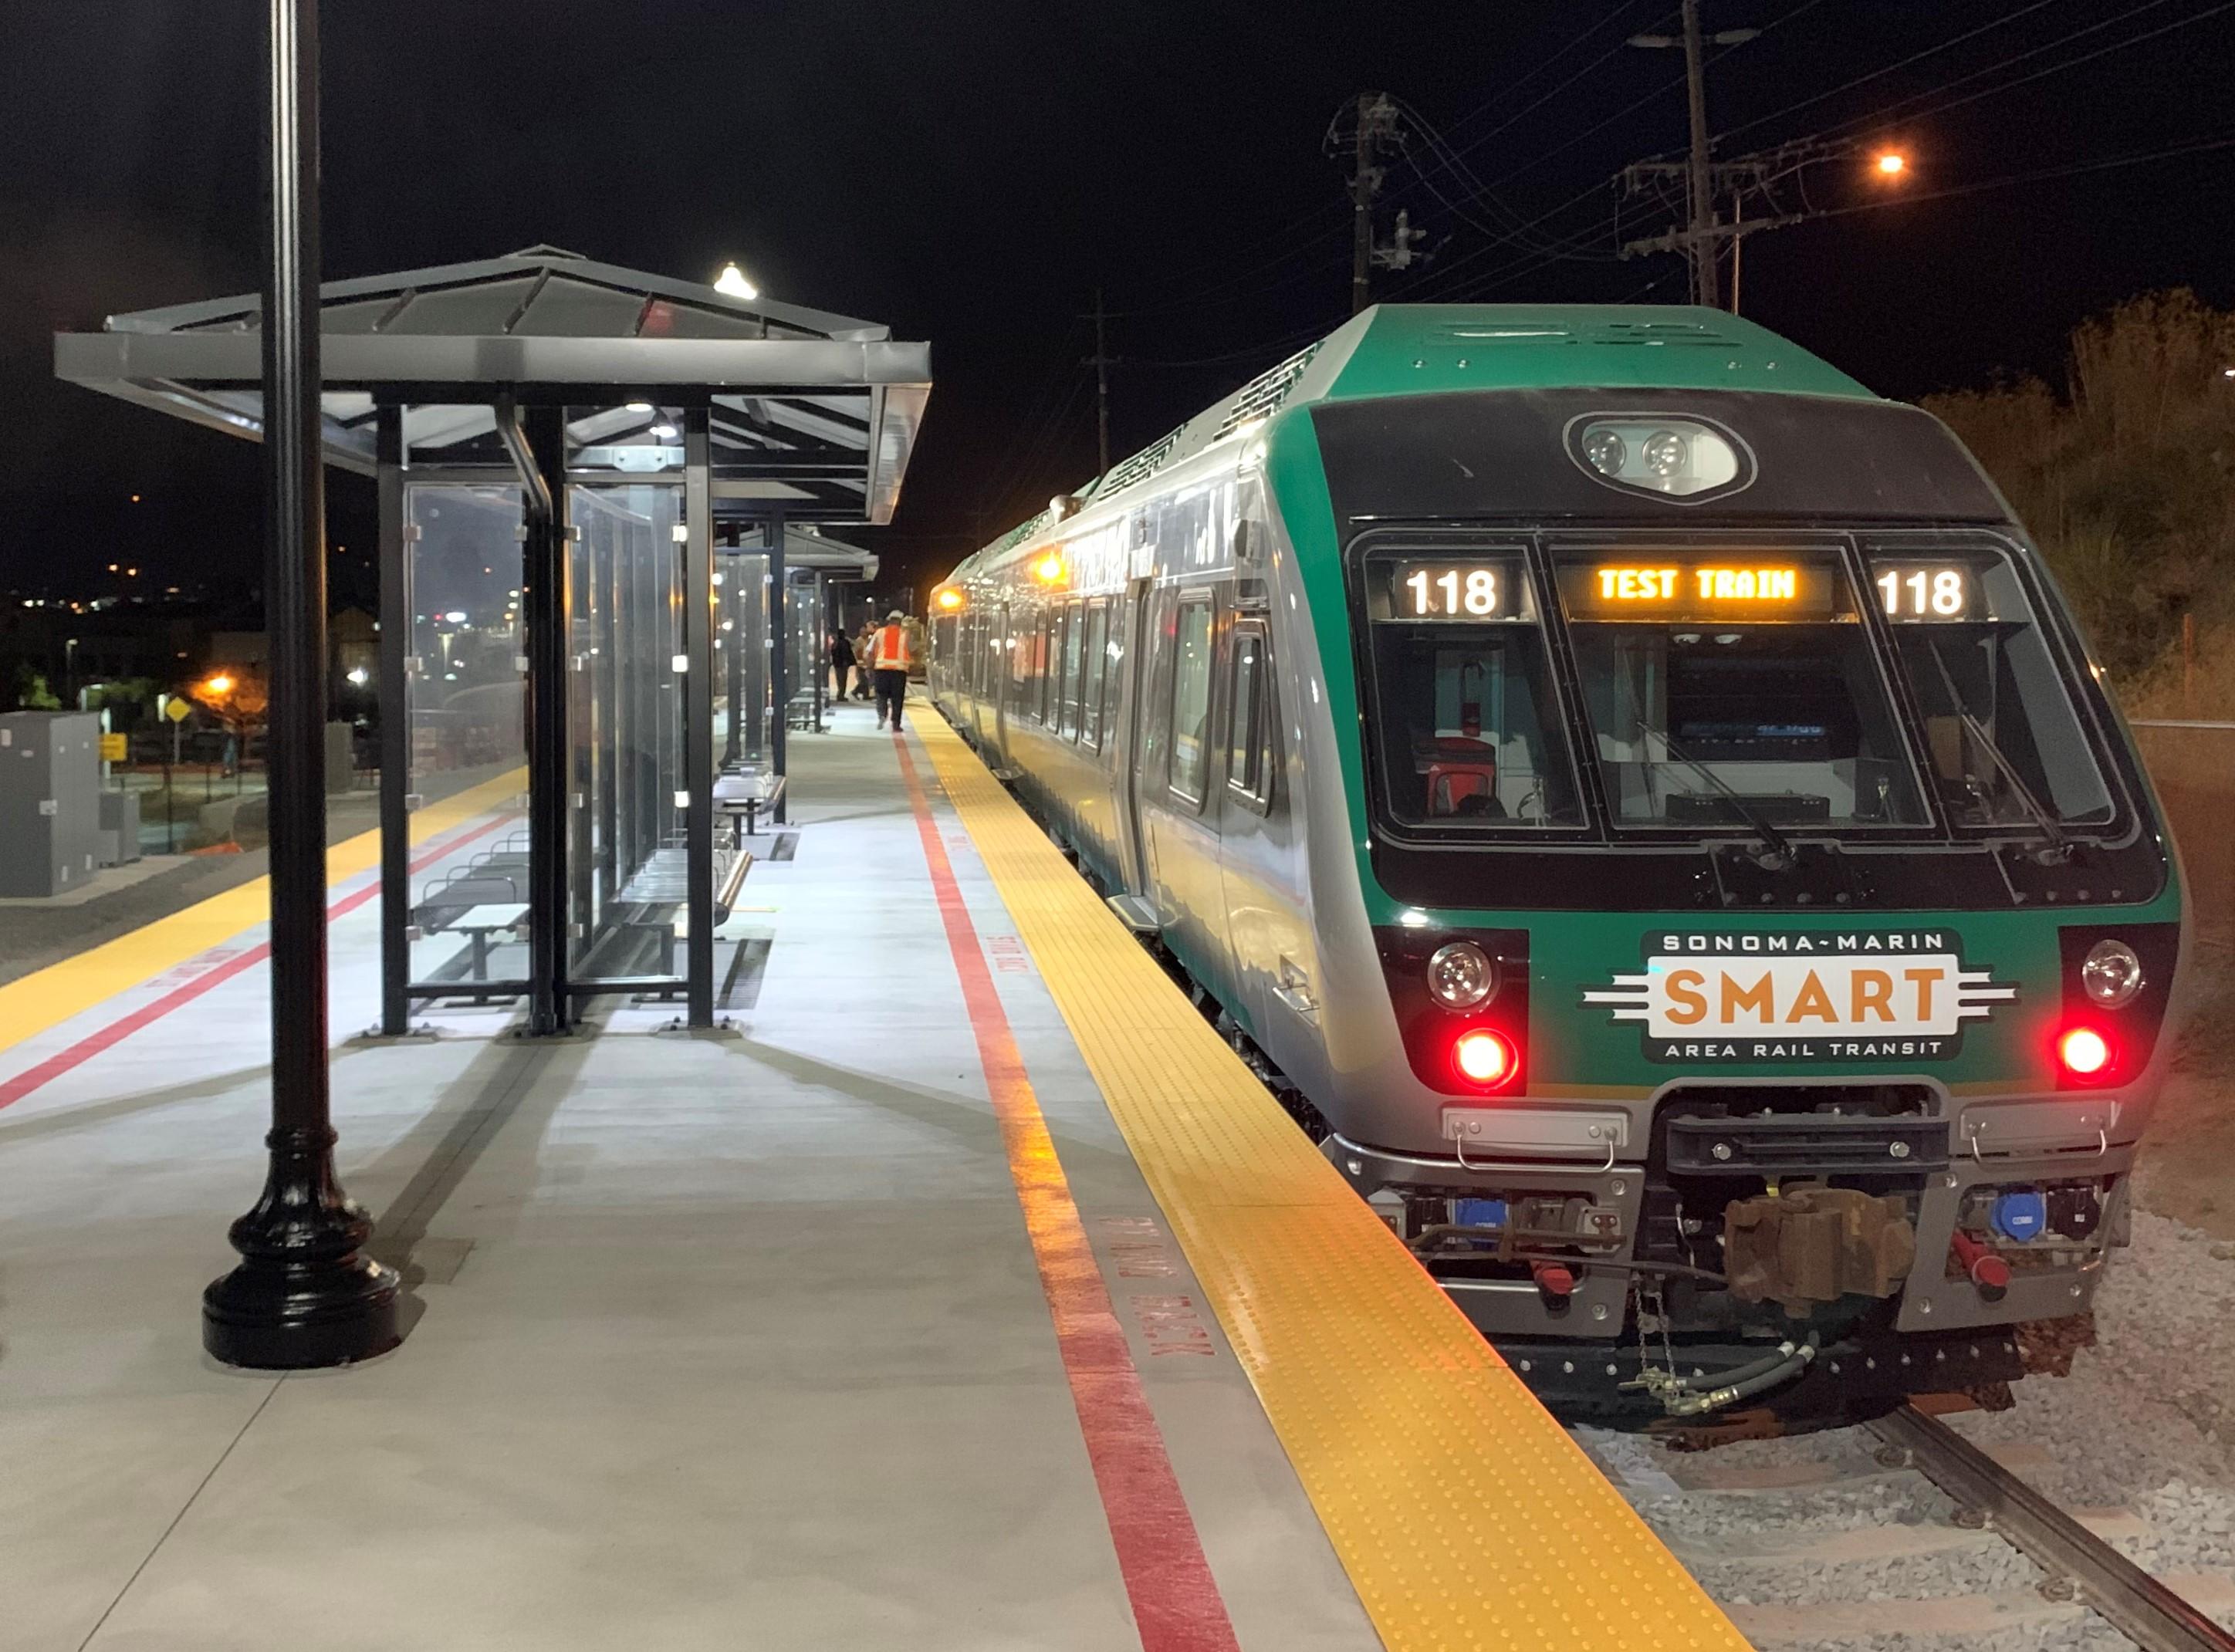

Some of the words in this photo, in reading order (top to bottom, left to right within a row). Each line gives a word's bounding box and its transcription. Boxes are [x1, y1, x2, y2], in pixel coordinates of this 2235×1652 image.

[1407, 570, 1496, 614] 118
[1598, 569, 1678, 599] TEST
[1696, 569, 1795, 599] TRAIN
[1878, 571, 1962, 614] 118
[1665, 968, 1944, 1025] SMART
[1665, 1044, 1736, 1056] AREA
[1753, 1043, 1814, 1056] RAIL
[1829, 1042, 1942, 1056] TRANSIT
